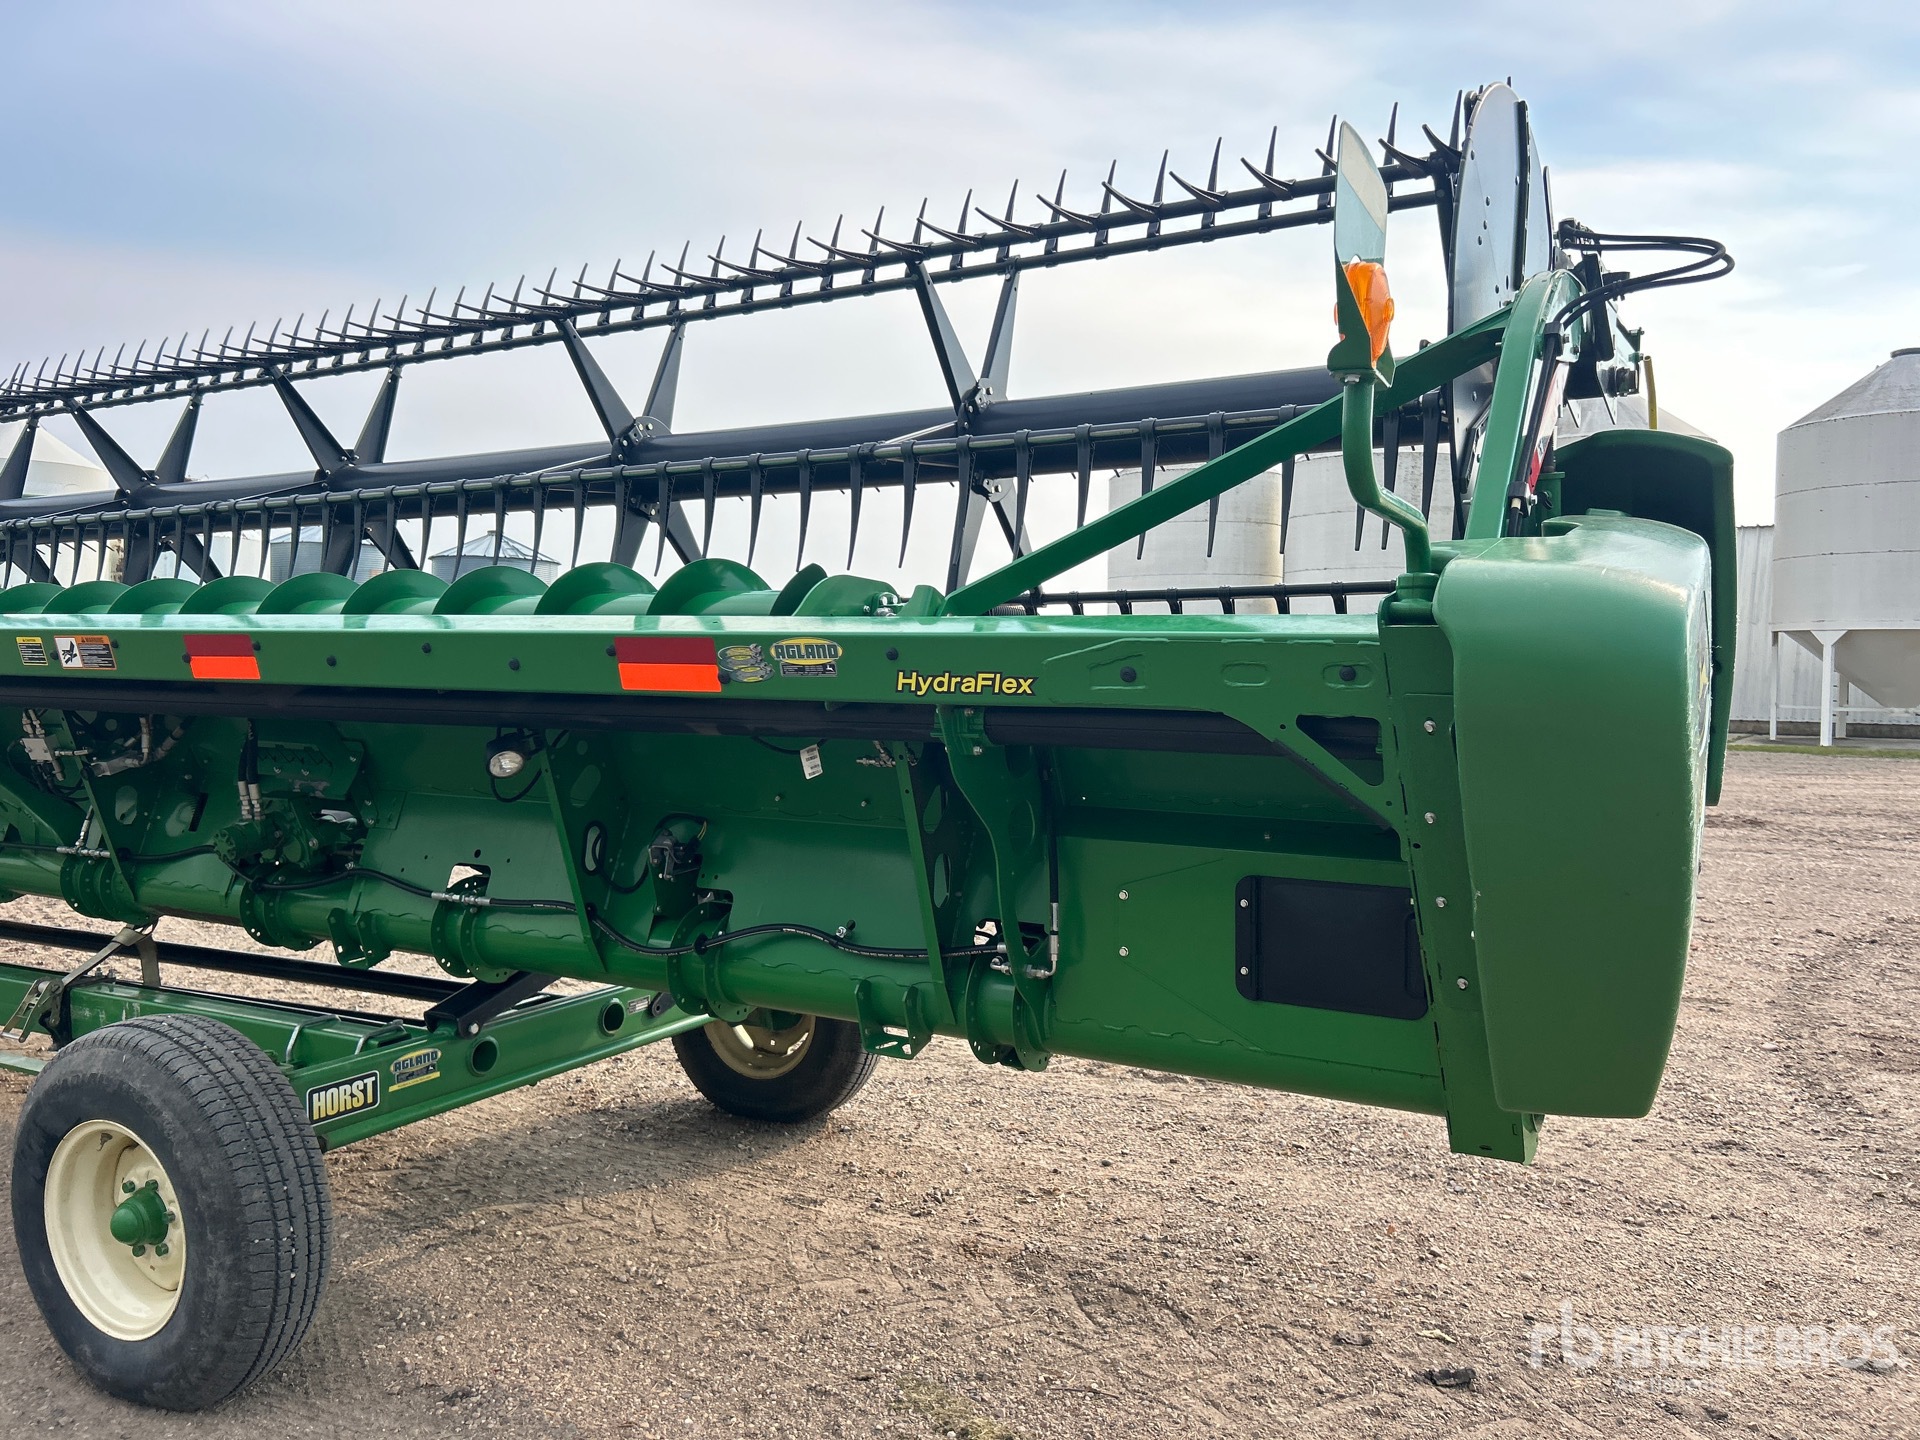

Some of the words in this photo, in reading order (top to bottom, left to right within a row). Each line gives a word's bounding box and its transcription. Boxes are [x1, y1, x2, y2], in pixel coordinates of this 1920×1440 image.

[774, 644, 838, 660] AGLAND
[897, 672, 1035, 695] HydraFlex
[394, 1050, 438, 1072] AGLAND
[312, 1076, 376, 1121] HORST
